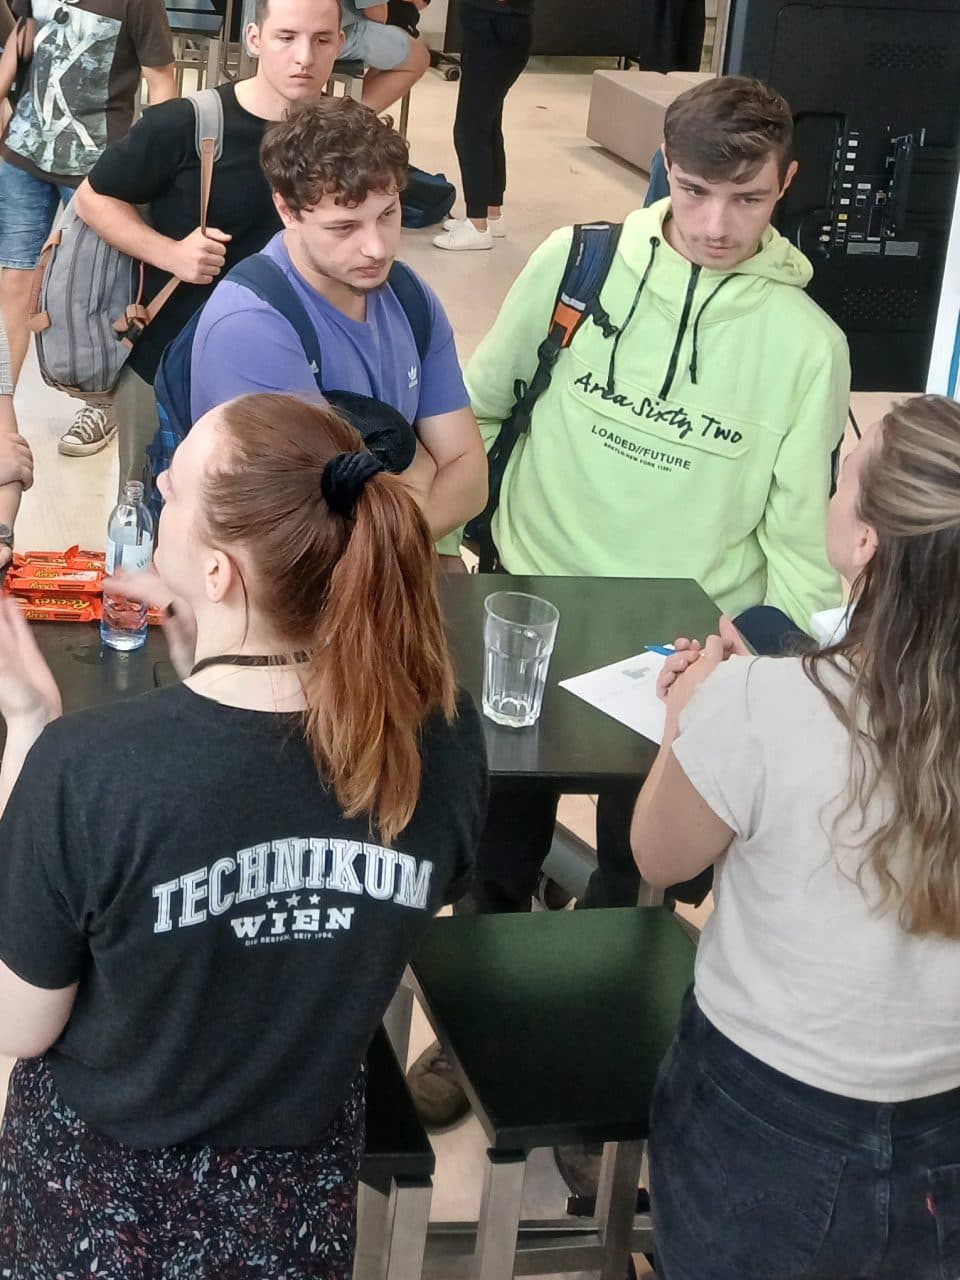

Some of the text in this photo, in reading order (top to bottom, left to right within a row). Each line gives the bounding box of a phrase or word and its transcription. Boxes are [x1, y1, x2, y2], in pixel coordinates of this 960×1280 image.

[574, 372, 743, 443] Area Sixty Two
[591, 425, 691, 470] LOADED//FUTURE
[152, 837, 434, 933] TECHNIKUM
[230, 907, 355, 938] WIEN
